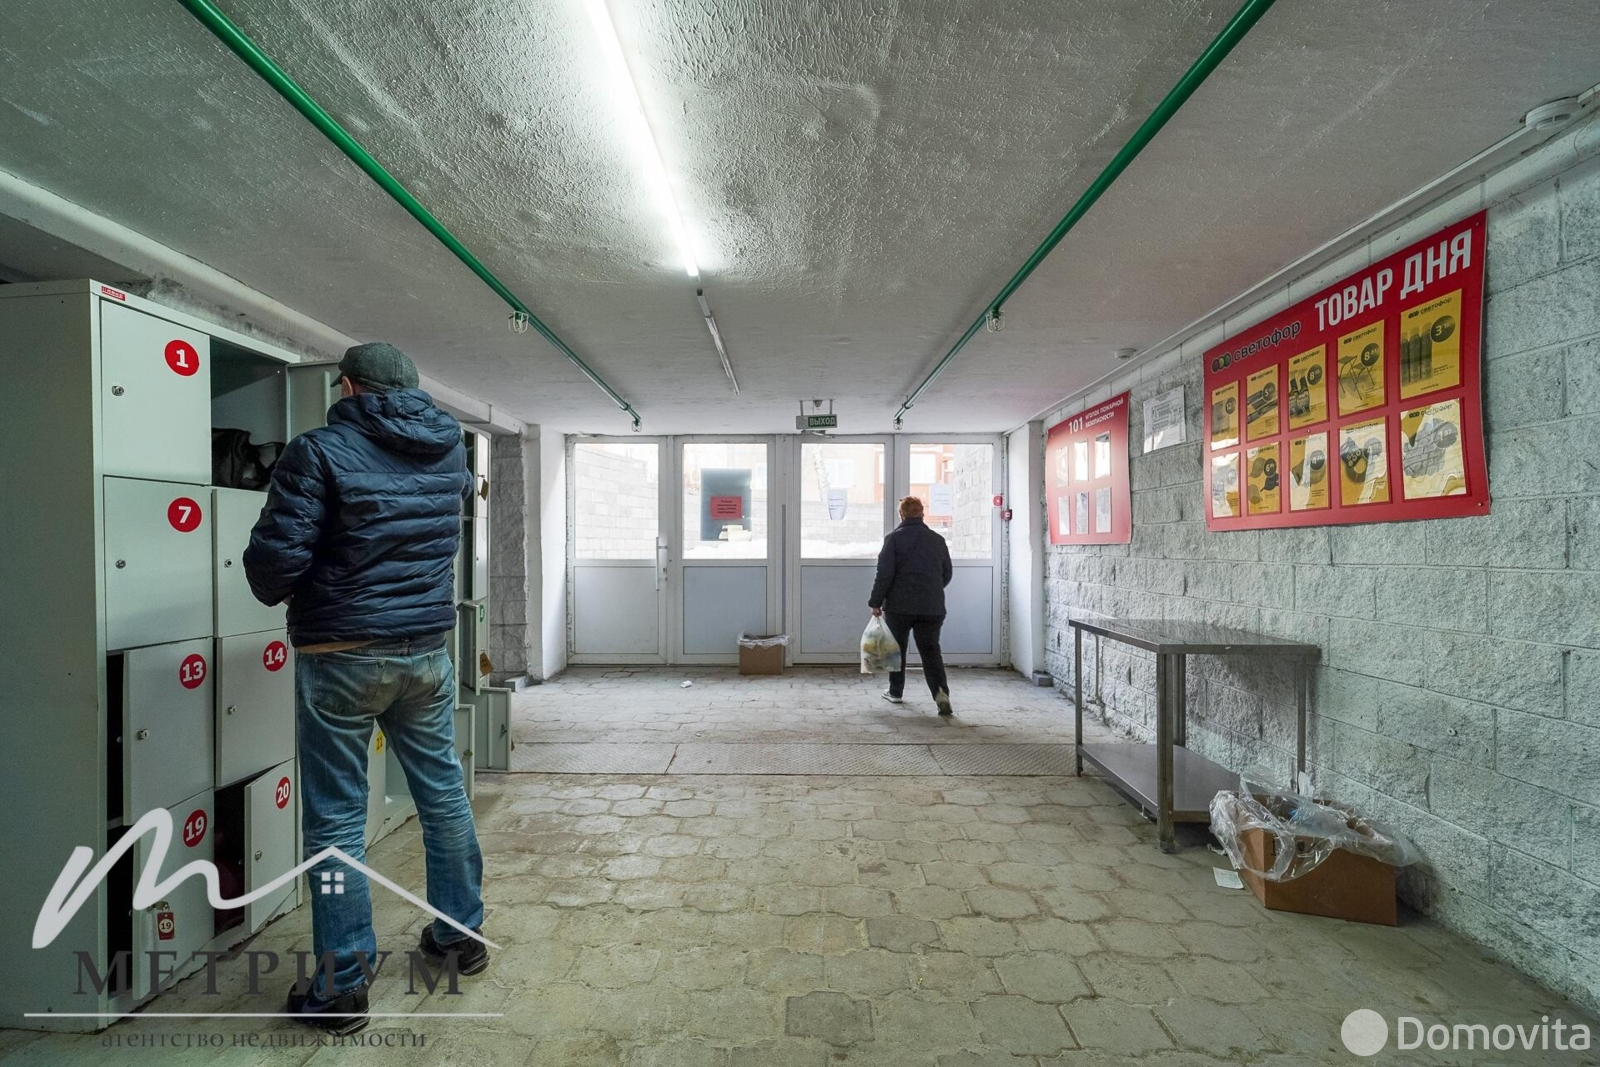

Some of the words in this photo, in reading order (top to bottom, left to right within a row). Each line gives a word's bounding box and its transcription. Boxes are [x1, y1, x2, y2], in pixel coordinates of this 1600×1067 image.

[1314, 267, 1393, 332] ТОВАР
[1400, 228, 1472, 300] ДНЯ
[1420, 297, 1453, 316] светофор
[1233, 320, 1302, 363] светофор
[176, 348, 189, 368] 1
[809, 416, 836, 426] ВЫХОД
[1069, 416, 1083, 435] 101
[178, 506, 192, 524] 7
[265, 646, 286, 666] 14
[182, 660, 205, 683] 13
[277, 782, 290, 805] 20
[185, 816, 205, 841] 19
[160, 921, 172, 931] 19
